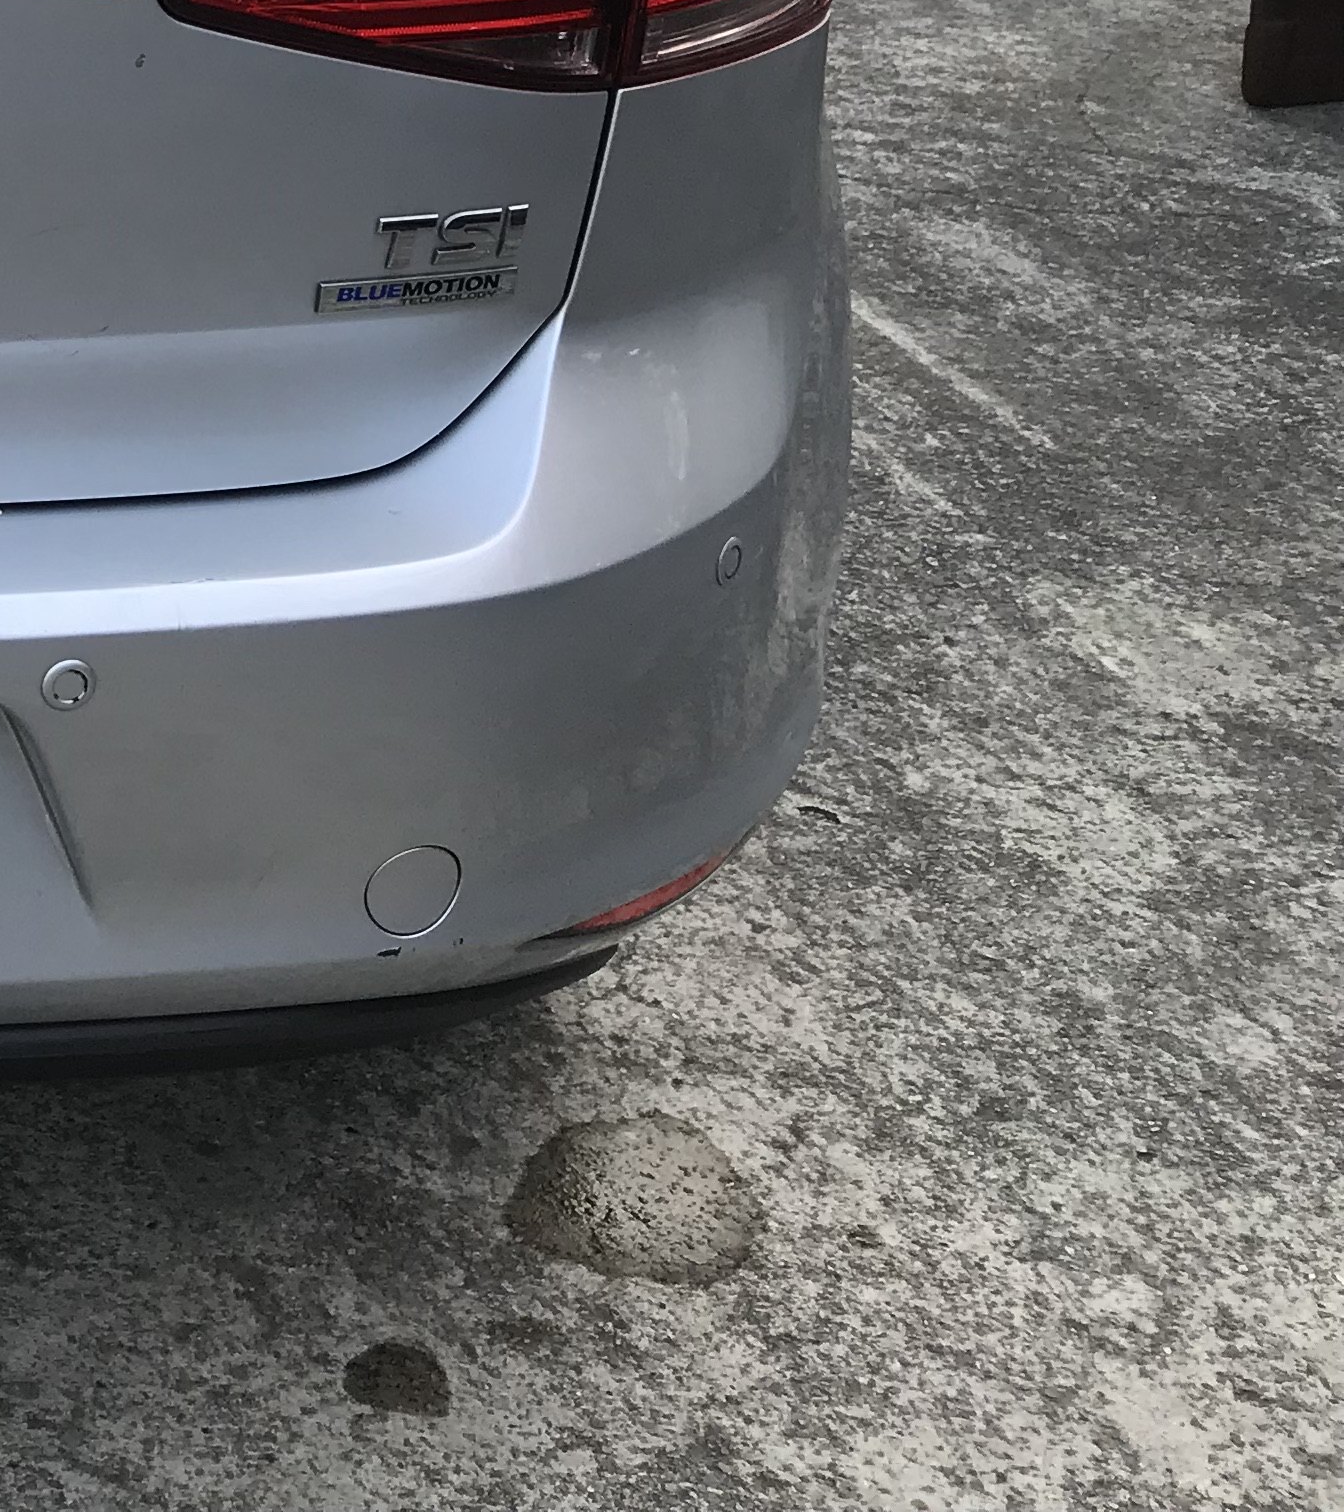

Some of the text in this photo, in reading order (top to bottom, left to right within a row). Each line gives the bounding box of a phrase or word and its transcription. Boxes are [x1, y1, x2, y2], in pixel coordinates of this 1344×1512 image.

[375, 203, 529, 269] TSI
[337, 273, 501, 303] BLUEMOTION
[400, 289, 498, 306] TECHNOLOGY
